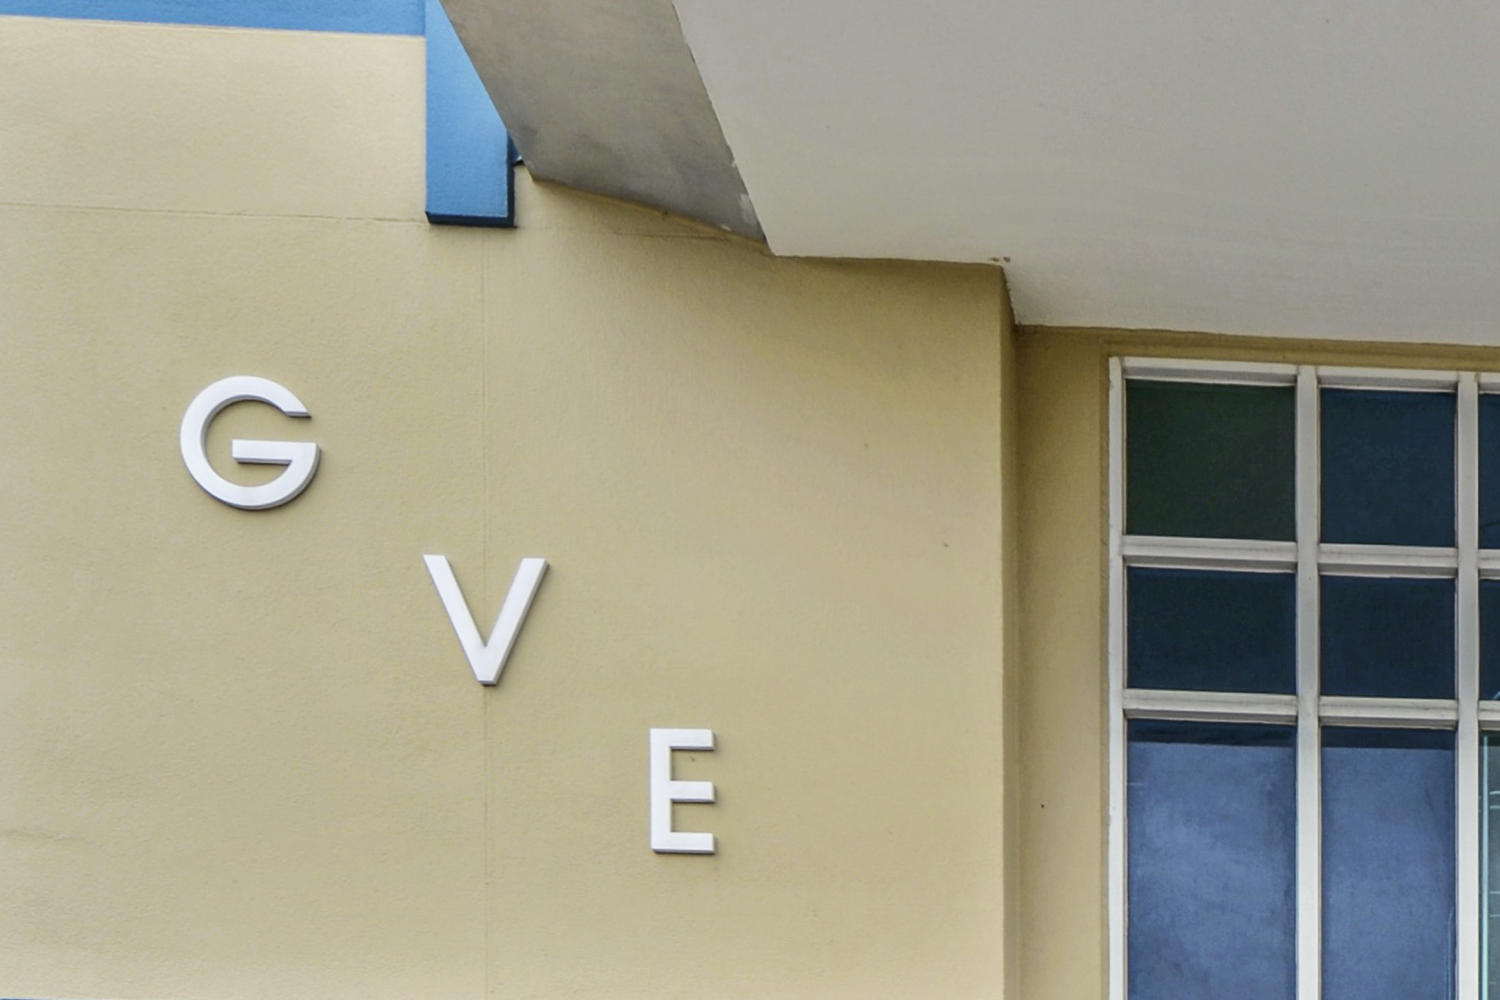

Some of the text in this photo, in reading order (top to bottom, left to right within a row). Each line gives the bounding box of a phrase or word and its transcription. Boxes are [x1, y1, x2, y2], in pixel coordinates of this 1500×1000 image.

[180, 375, 320, 510] G
[423, 554, 549, 687] V
[650, 728, 716, 854] E
